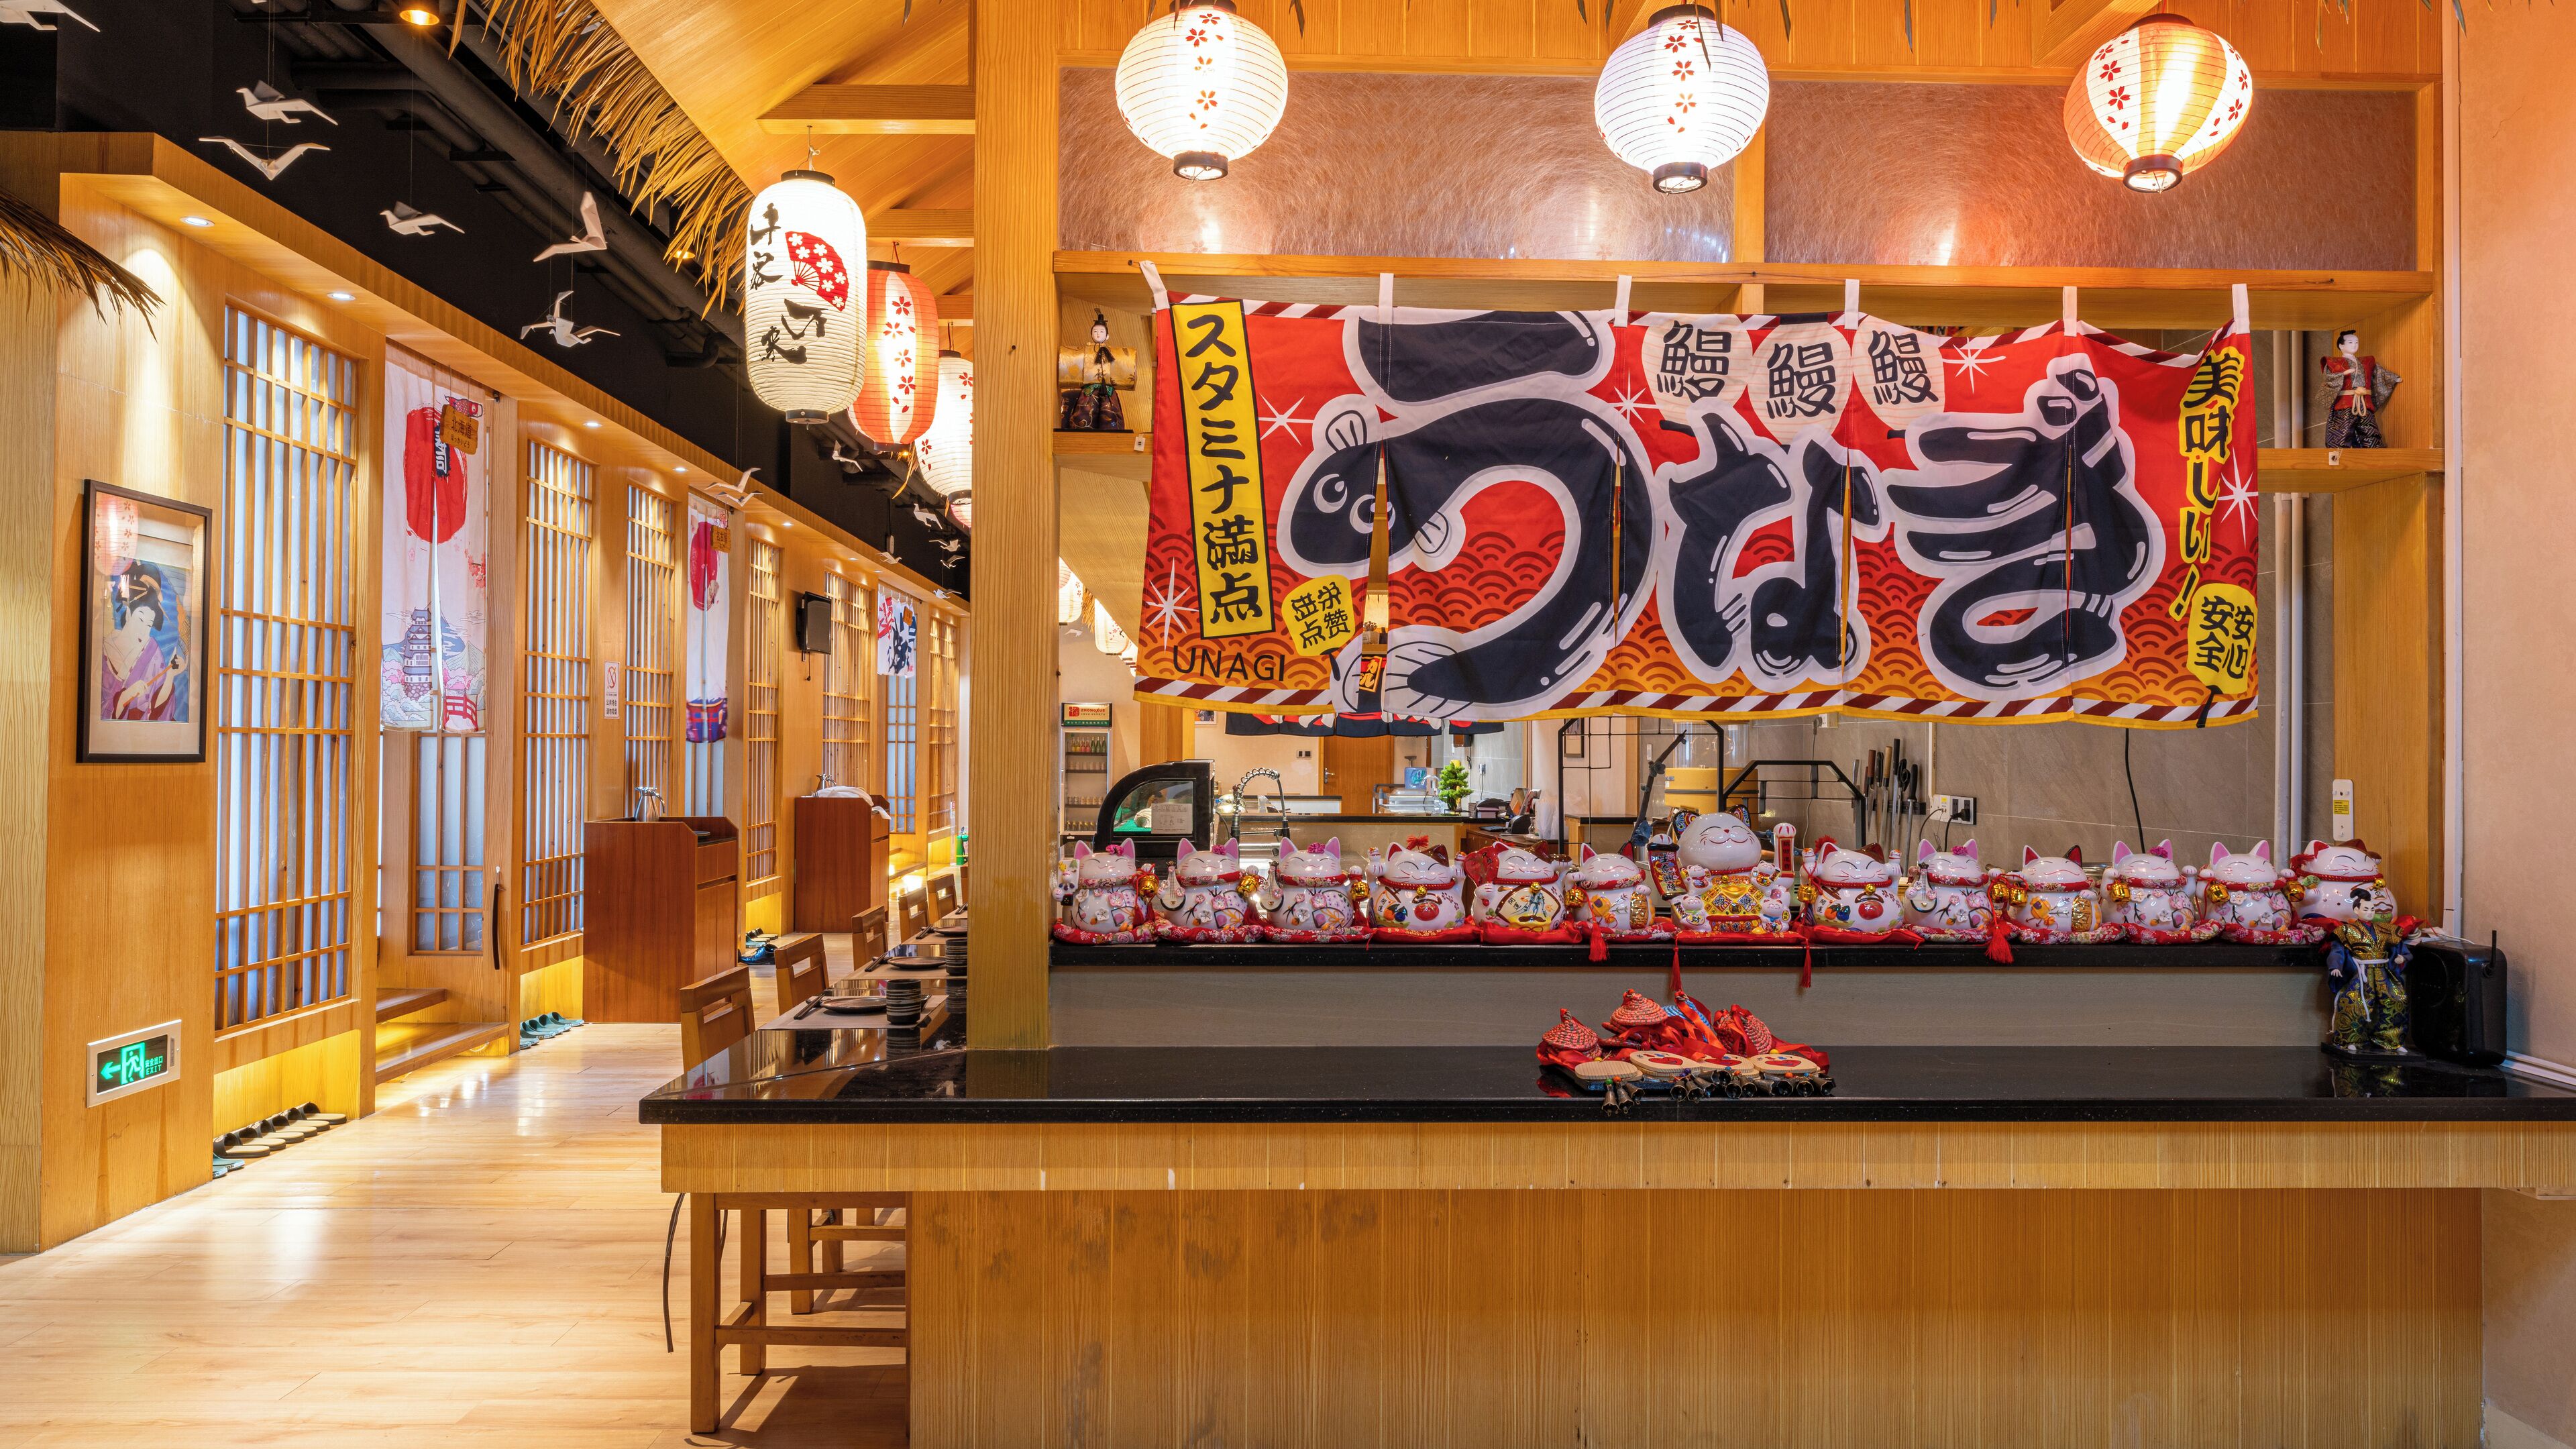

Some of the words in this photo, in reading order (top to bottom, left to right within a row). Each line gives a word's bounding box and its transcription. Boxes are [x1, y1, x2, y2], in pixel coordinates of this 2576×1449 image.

[1656, 320, 1733, 402] 鰻
[1766, 342, 1837, 419] 鰻
[1867, 329, 1939, 405] 鰻
[451, 417, 472, 439] 北海道
[450, 433, 471, 449] ほっかいどう
[1184, 314, 1263, 624] スタミナ満点
[1172, 645, 1286, 682] UNAGI
[145, 1055, 164, 1068] 安全出口
[146, 1064, 162, 1076] EXIT
